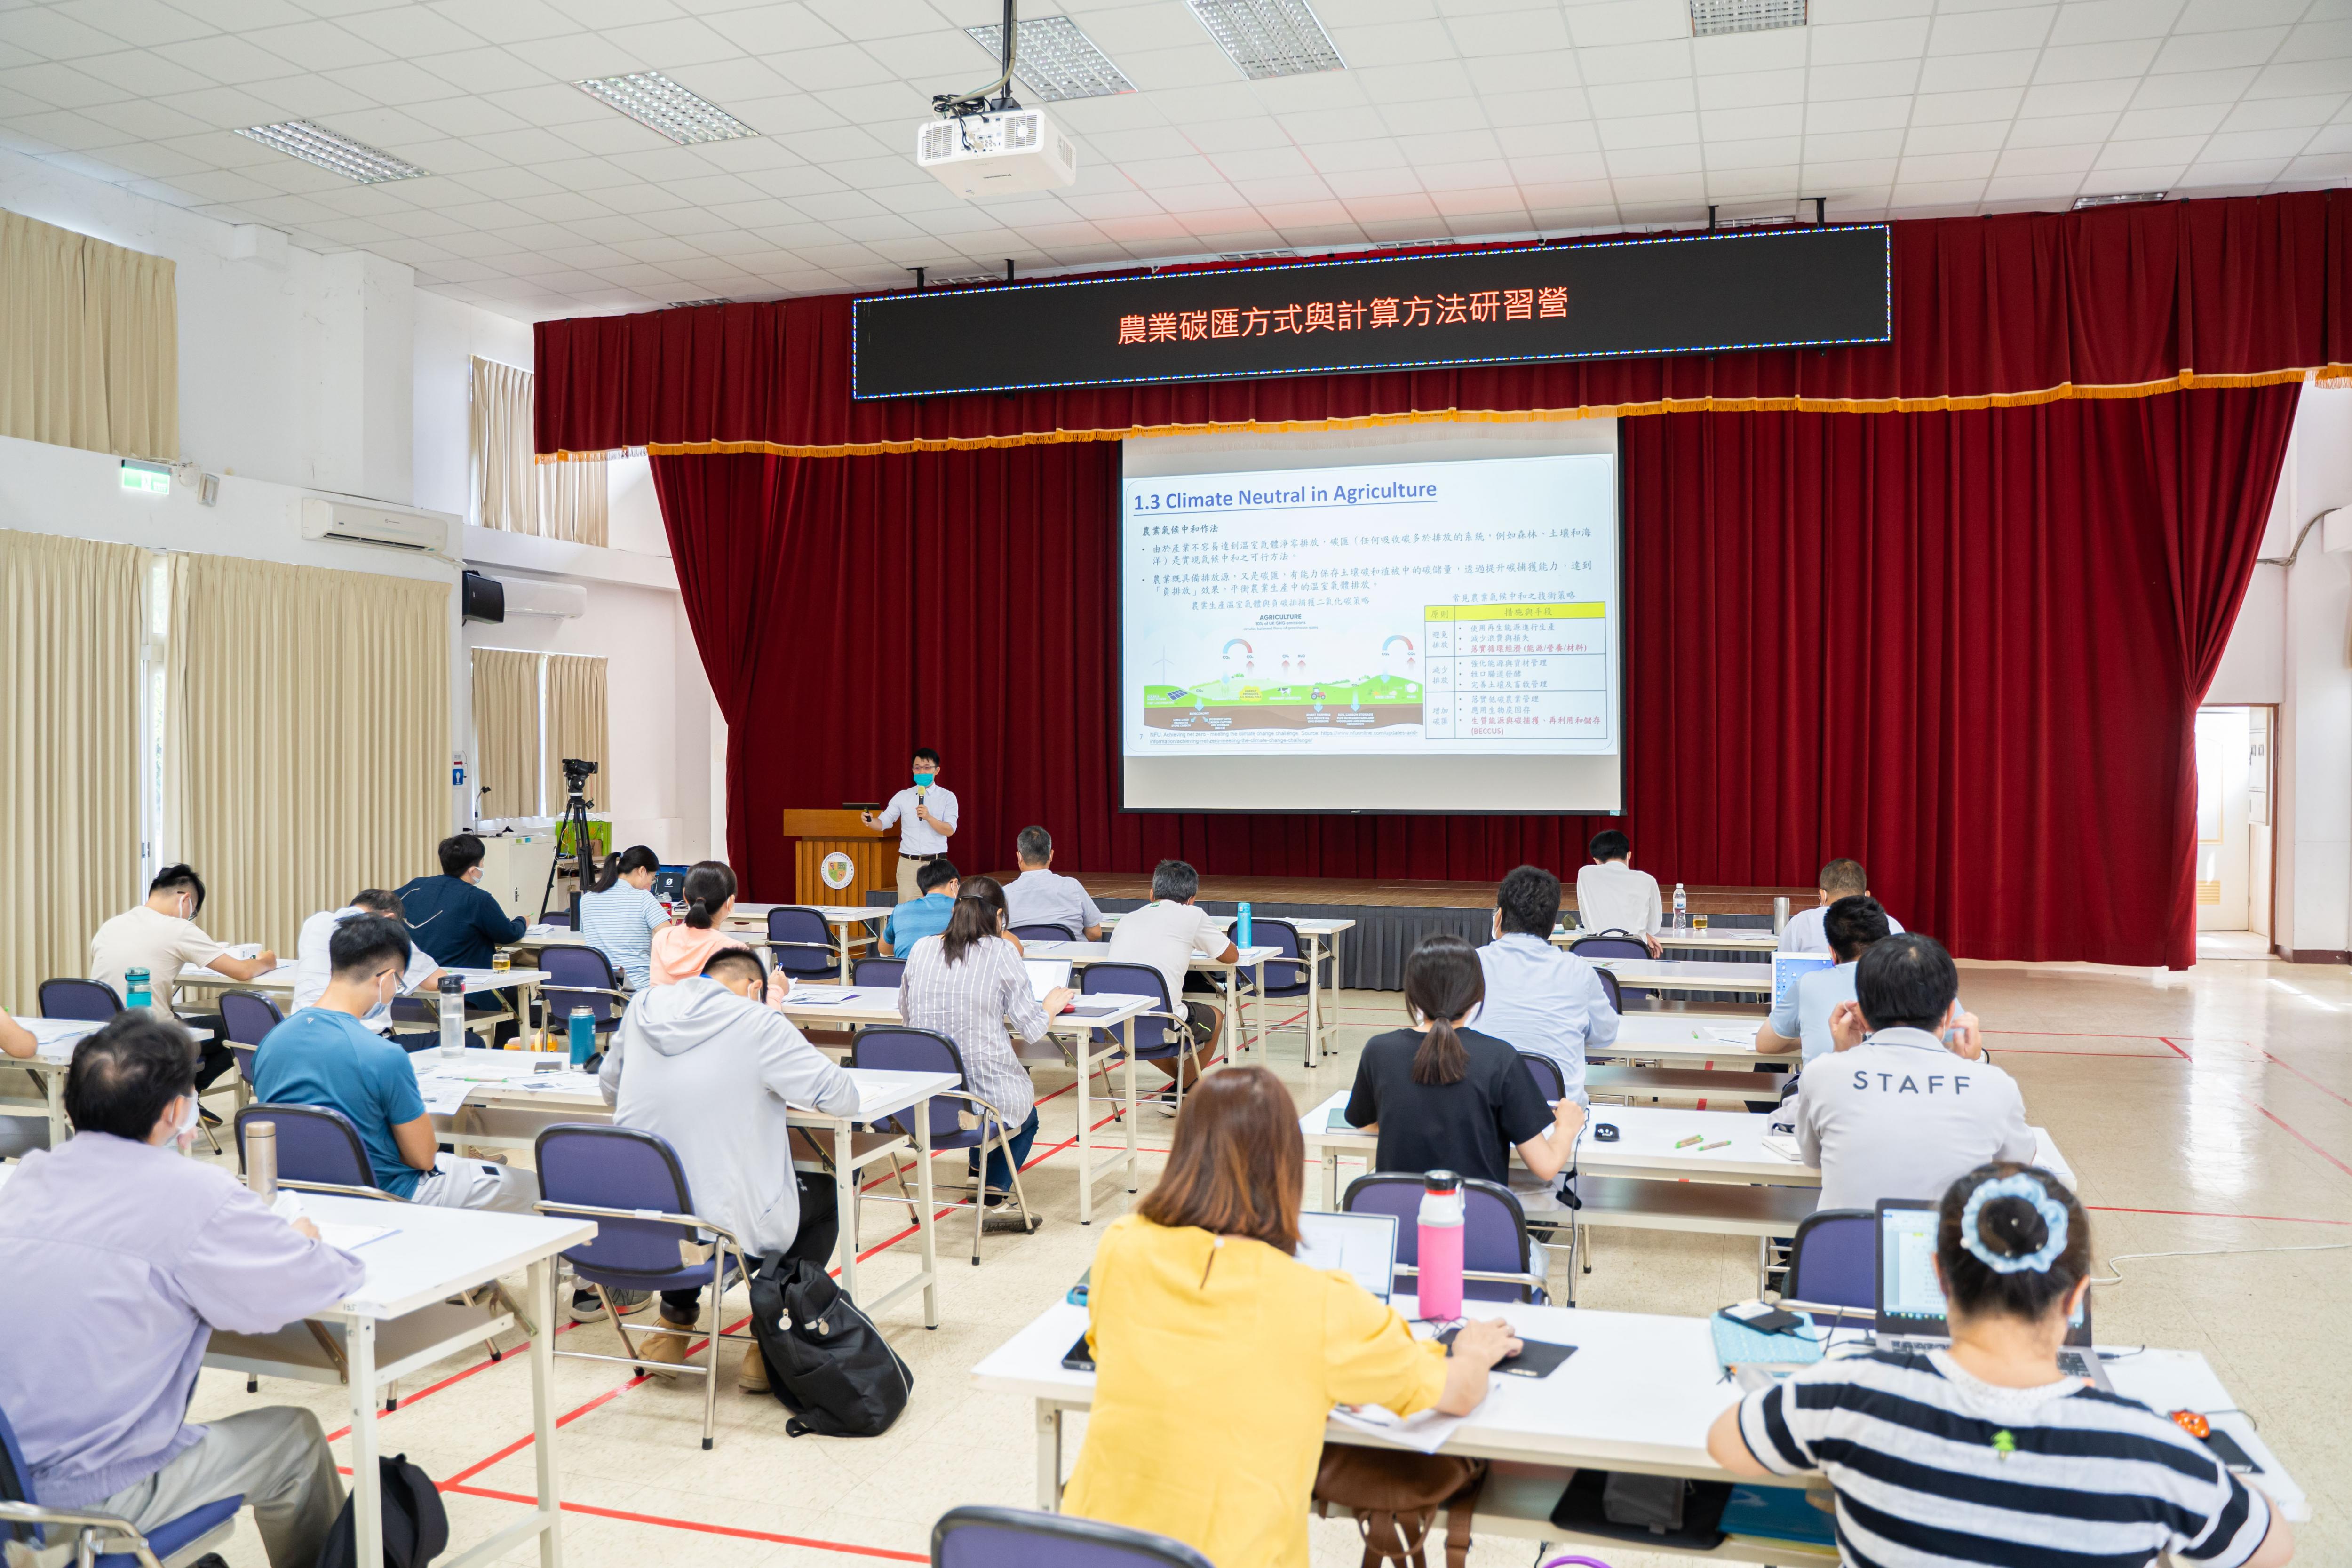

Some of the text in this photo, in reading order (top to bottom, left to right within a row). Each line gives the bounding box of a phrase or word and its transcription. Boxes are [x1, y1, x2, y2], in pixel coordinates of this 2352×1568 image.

[1118, 287, 1568, 345] 農業碳匯方式與計算方法研習營
[1134, 481, 1437, 510] 1.3 Climate Neutral in Agriculture
[1142, 524, 1219, 536] 農業氣候中和作法
[1431, 610, 1448, 619] 原則
[1471, 727, 1504, 736] (BECCUS)
[1852, 1070, 1971, 1095] STAFF
